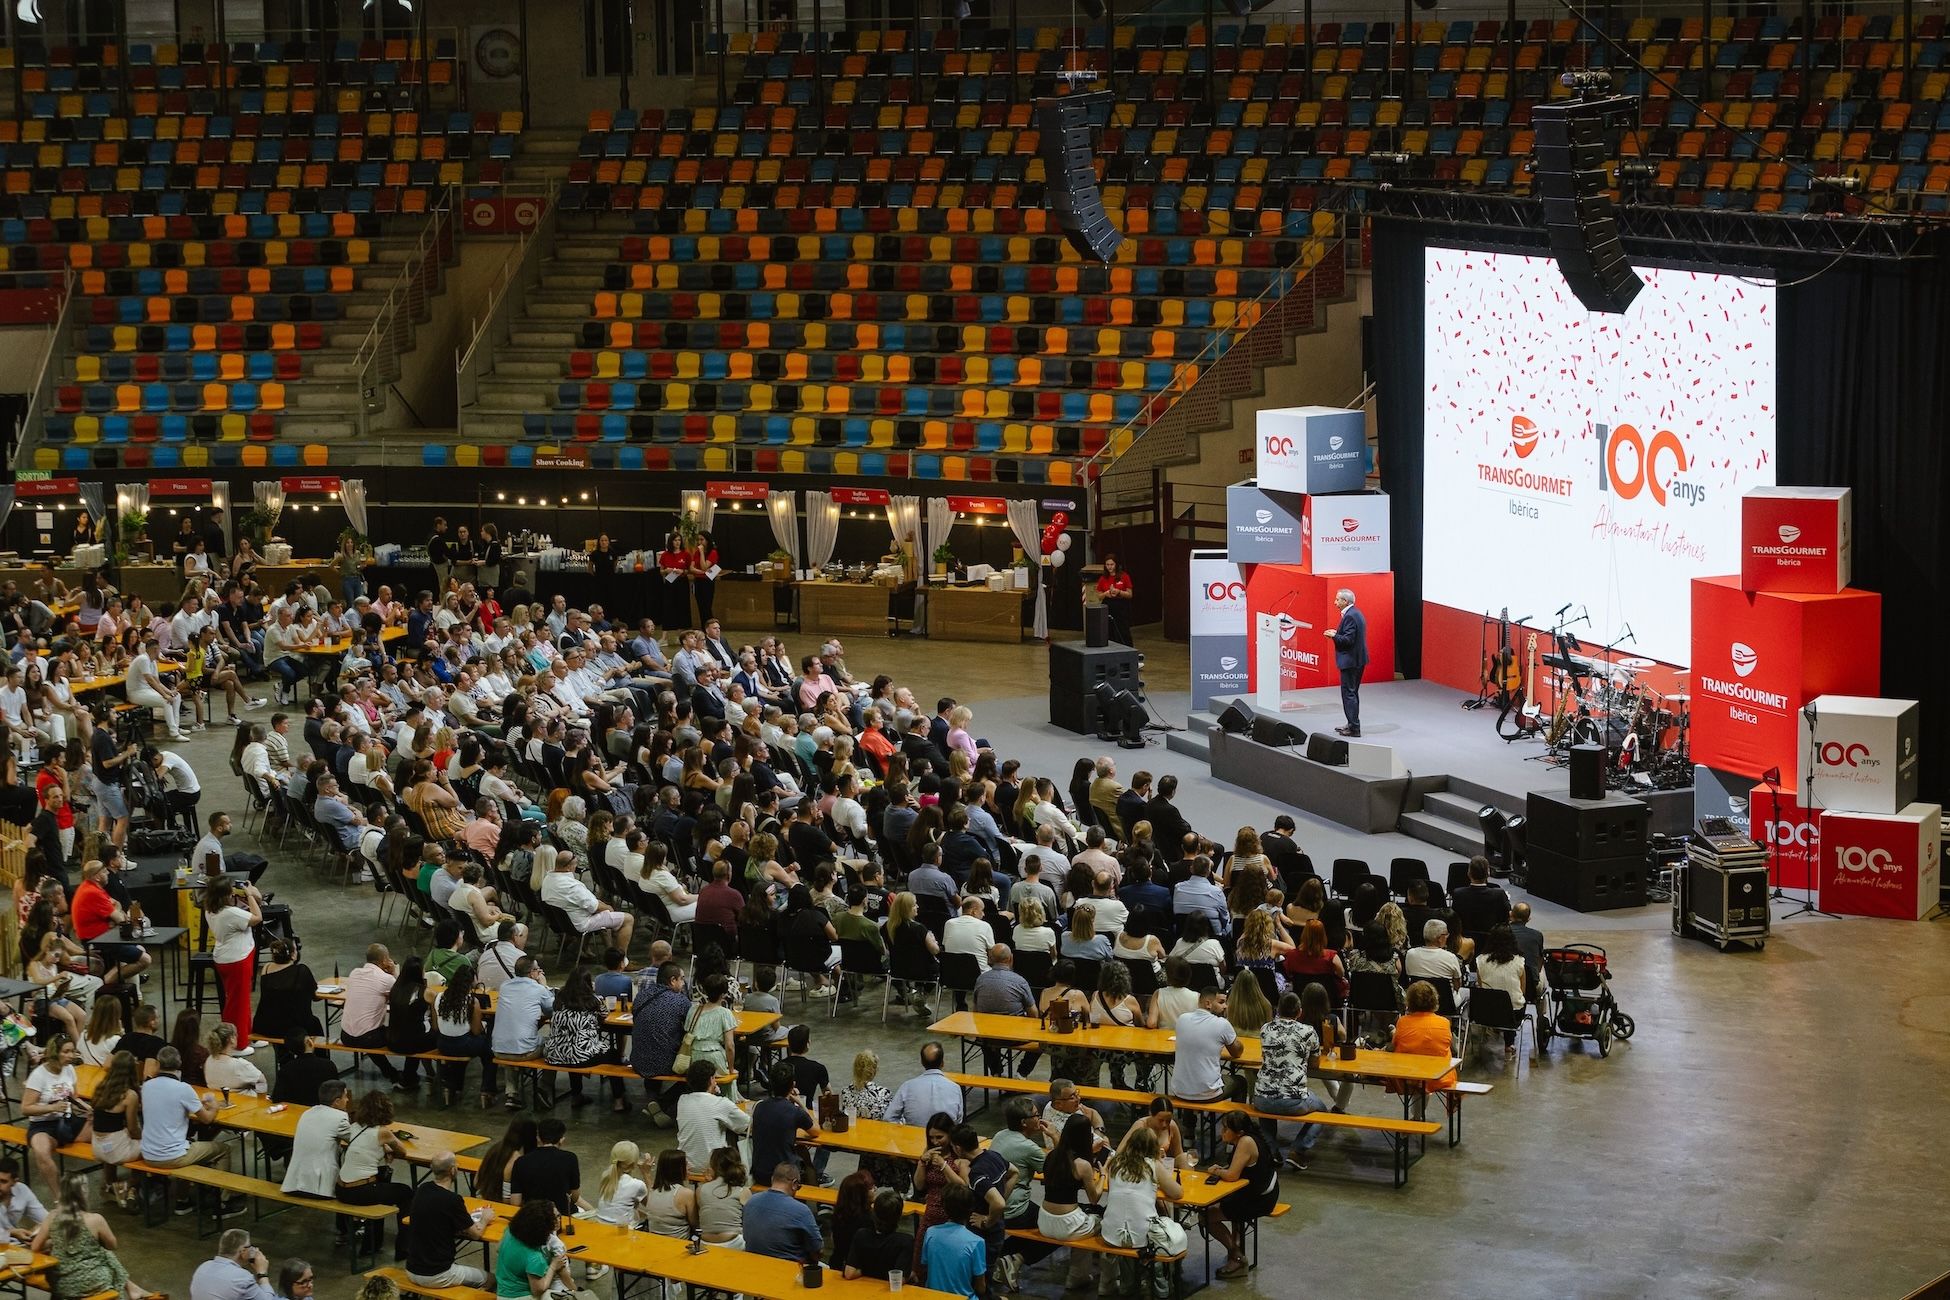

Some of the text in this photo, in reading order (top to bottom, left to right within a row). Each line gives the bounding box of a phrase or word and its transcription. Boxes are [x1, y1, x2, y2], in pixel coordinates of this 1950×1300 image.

[1264, 436, 1293, 456] 100
[555, 459, 584, 467] Cooking
[1313, 451, 1359, 462] TRANSGOURMET
[1595, 423, 1705, 507] 100 anys
[1477, 463, 1573, 497] TRANSGOURMET
[1509, 498, 1539, 520] Ibèrica
[1236, 525, 1293, 534] TRANSGOURMET
[1321, 535, 1381, 543] TRANSGOURMET
[1752, 545, 1827, 556] TRANSGOURMET
[1776, 558, 1802, 566] Ibèrica
[1280, 645, 1319, 666] GOURMET
[1200, 672, 1248, 680] TRANSGOURM
[1279, 666, 1297, 679] bèrica
[1701, 676, 1788, 709] TRANSGOURMET
[1729, 705, 1758, 724] Ibèrica
[1814, 741, 1870, 768] 100
[1861, 758, 1880, 767] anys
[1835, 846, 1893, 874] 100
[1883, 863, 1903, 874] anys
